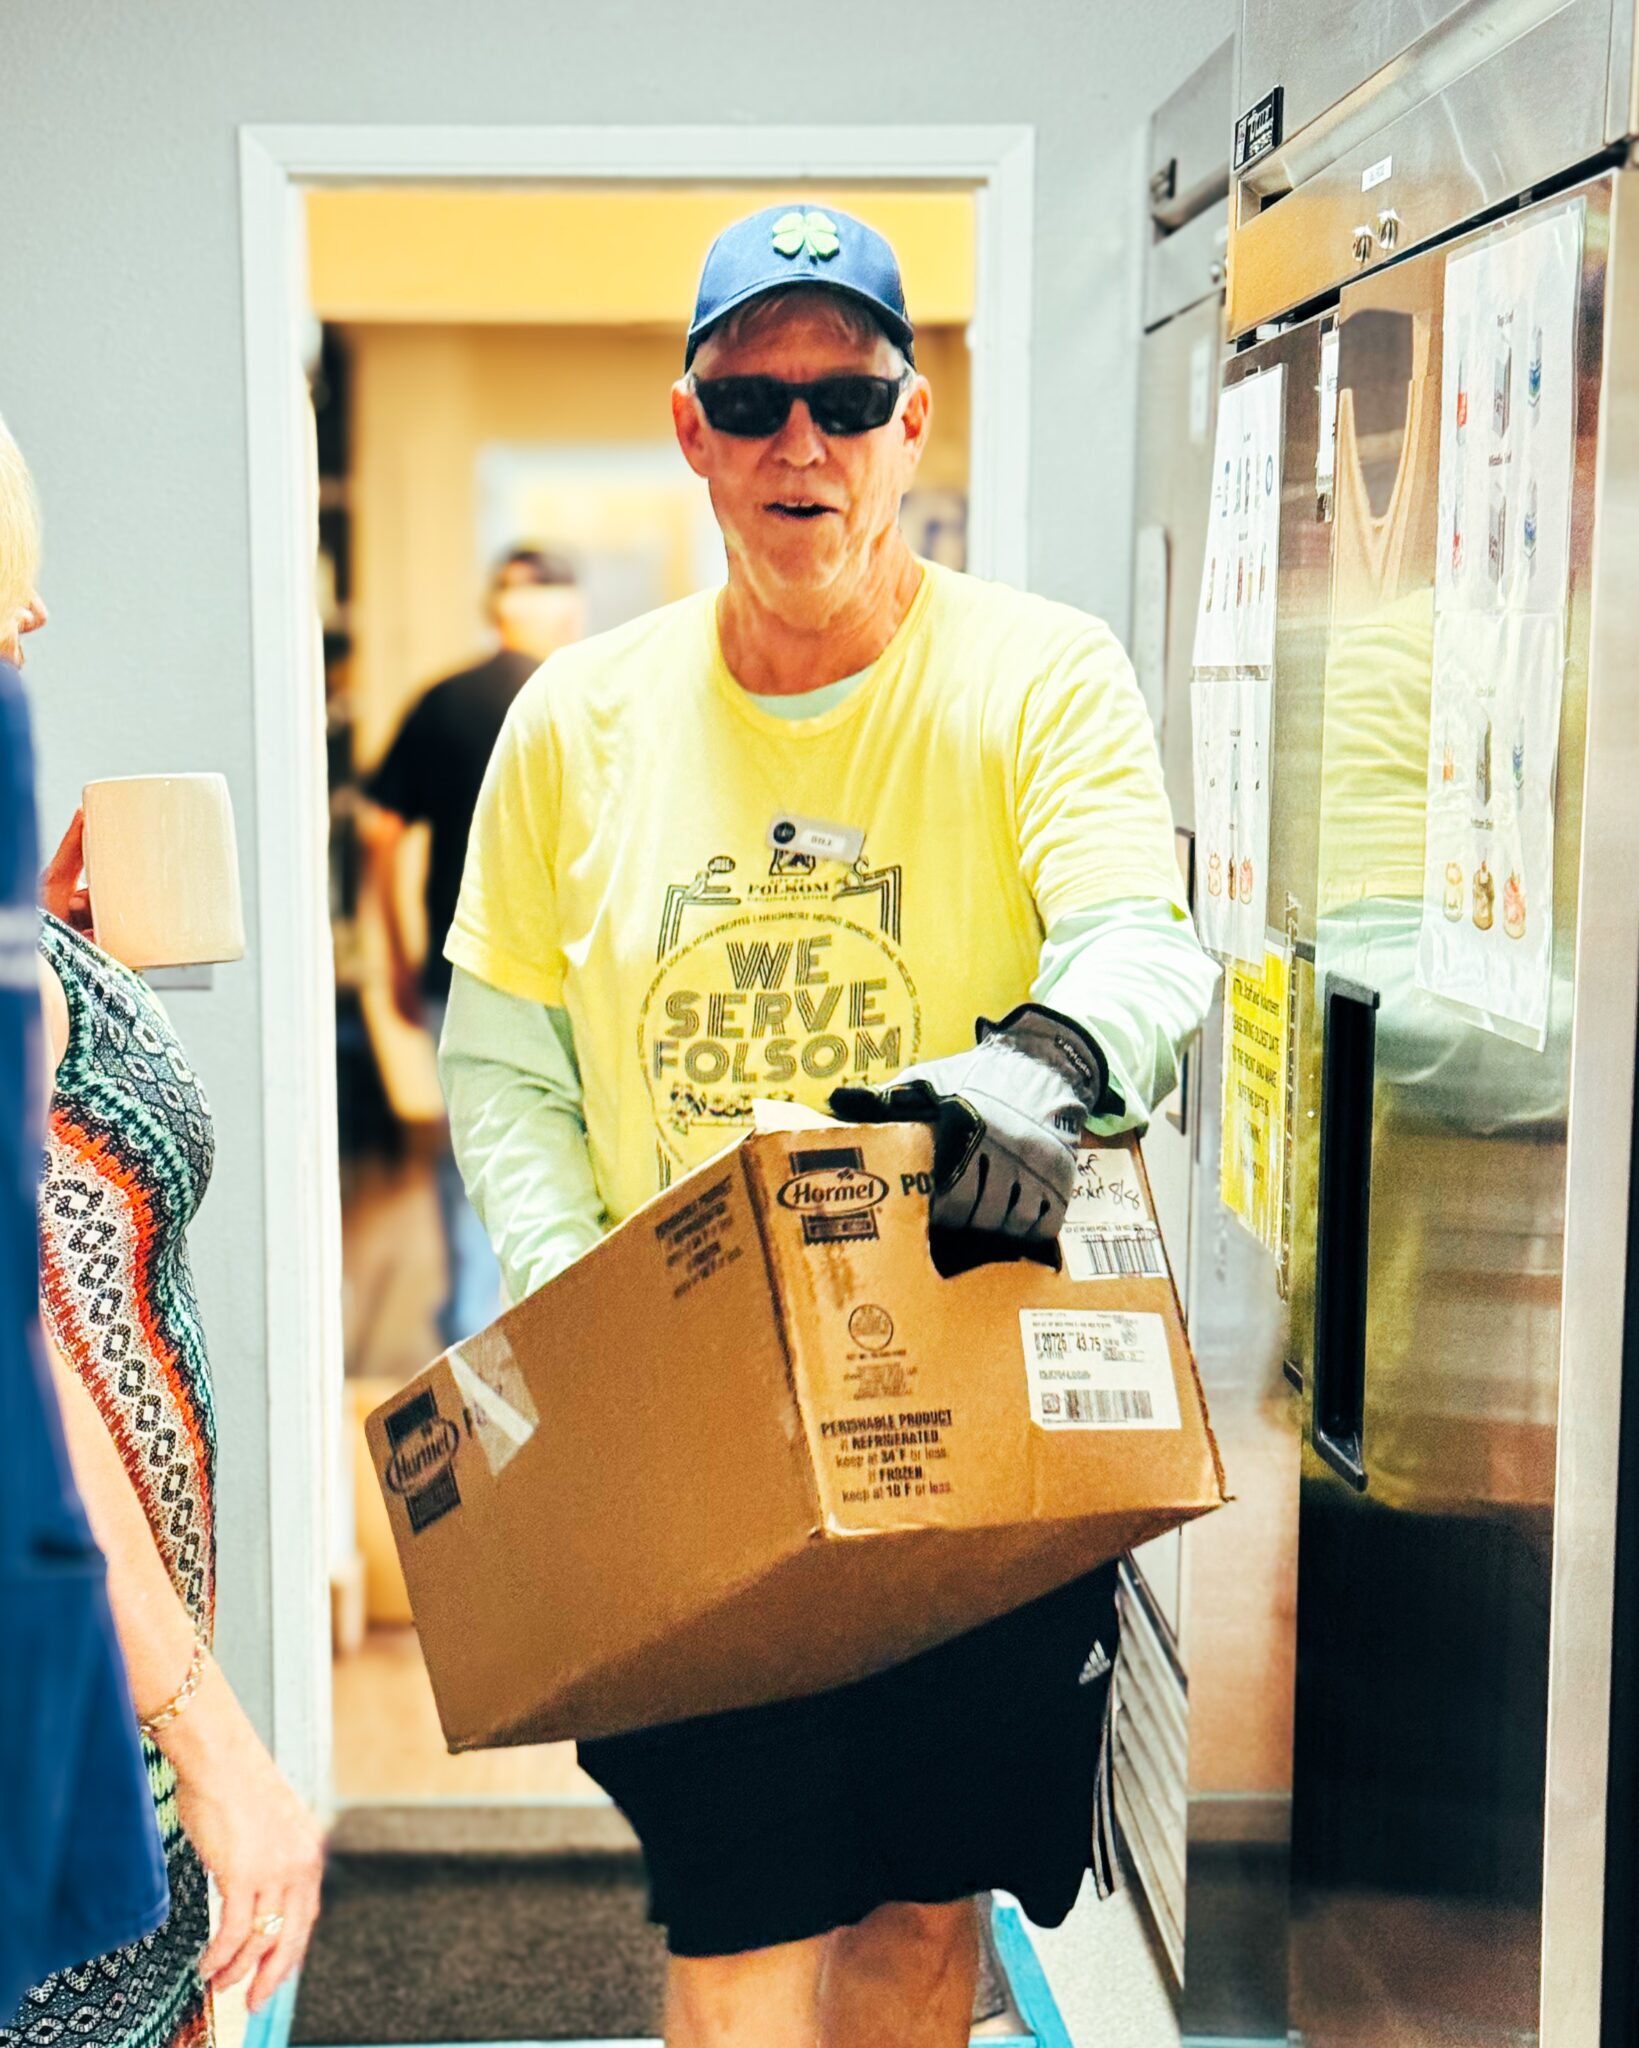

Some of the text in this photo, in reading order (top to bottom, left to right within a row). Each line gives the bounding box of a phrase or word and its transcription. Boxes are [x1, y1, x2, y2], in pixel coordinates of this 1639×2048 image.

[726, 934, 833, 990] WE
[665, 977, 888, 1040] SERVE
[653, 1026, 901, 1085] FOLSOM
[793, 1171, 934, 1204] Hormel PO
[820, 1409, 952, 1437] PERISHABLE PRODUCT
[852, 1430, 939, 1450] REFRIGERATED
[879, 1466, 923, 1482] FROZEN
